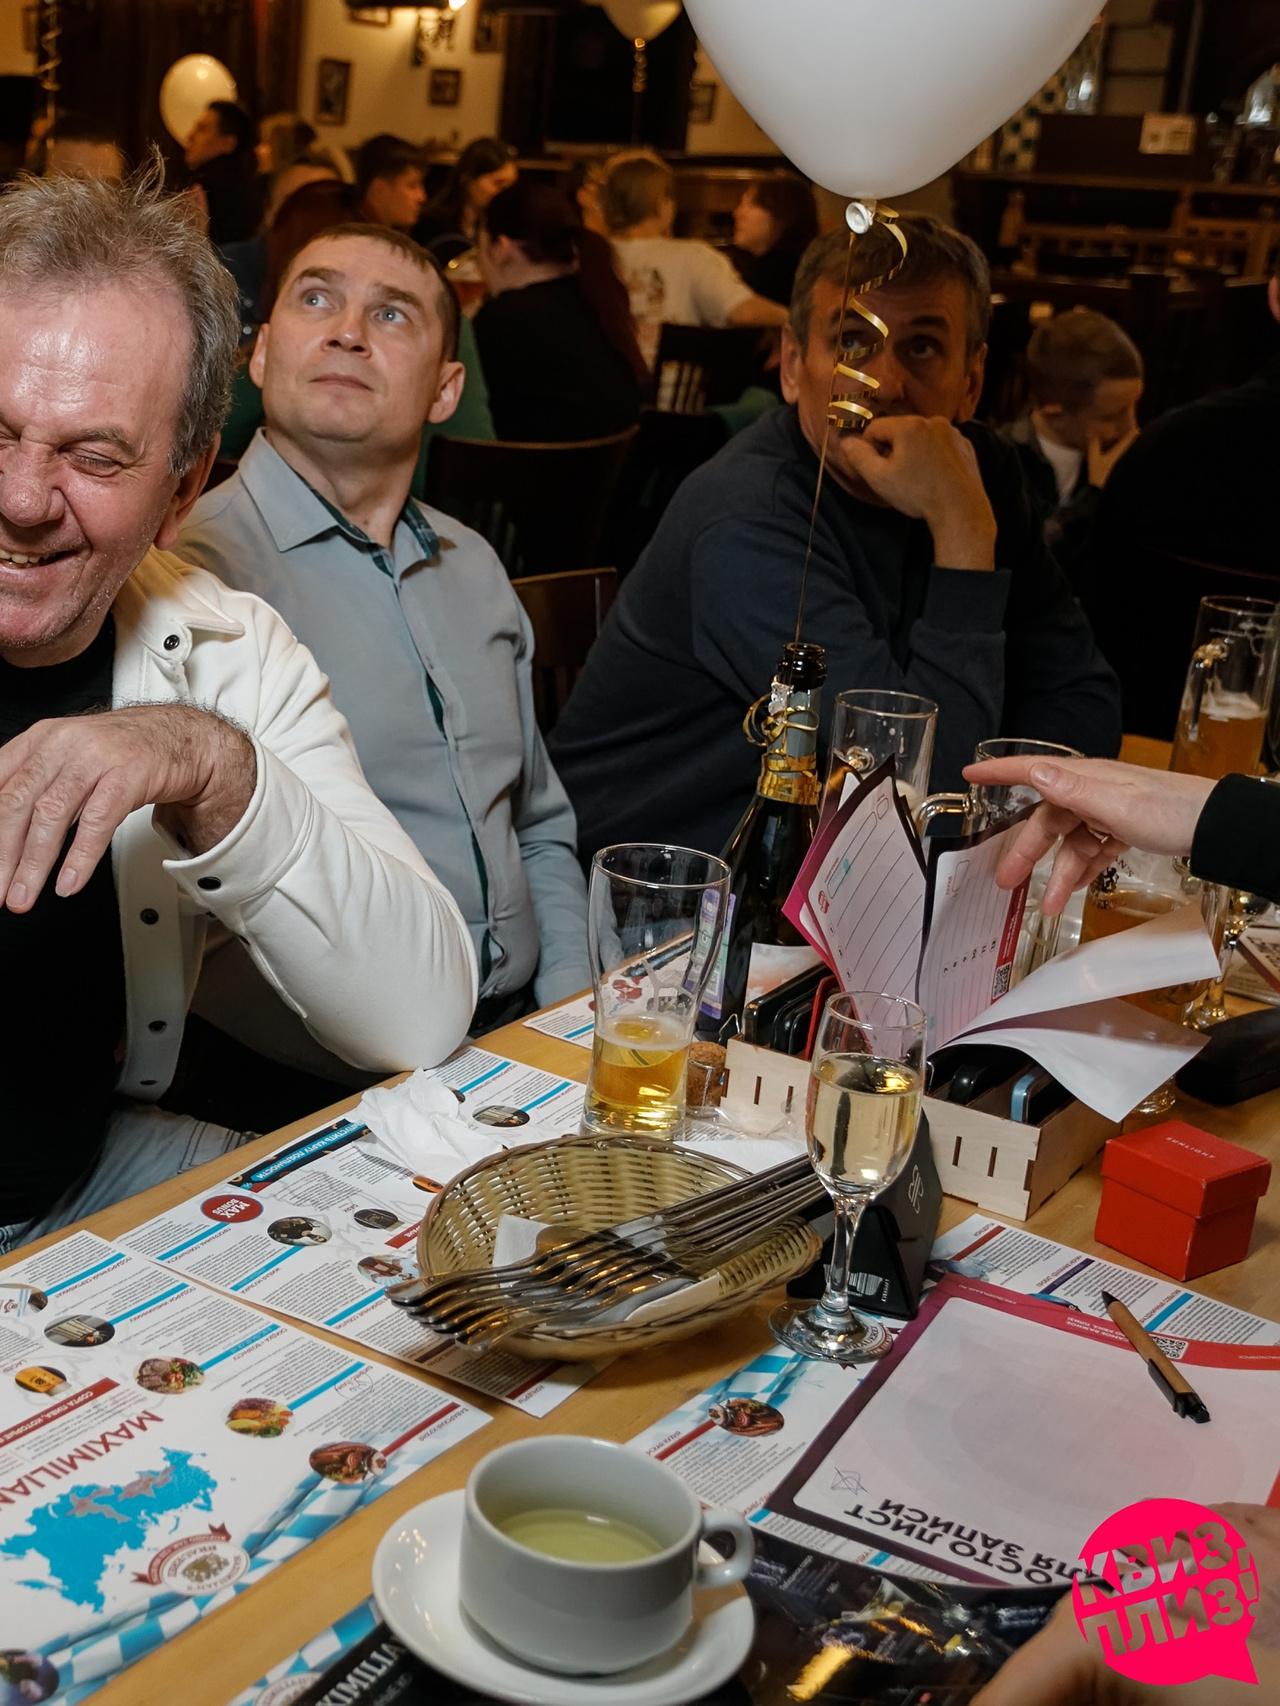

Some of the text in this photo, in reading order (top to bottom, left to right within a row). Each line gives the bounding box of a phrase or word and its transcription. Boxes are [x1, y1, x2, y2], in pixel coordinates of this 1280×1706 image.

[302, 1137, 326, 1156] КАРТУ
[1164, 1135, 1216, 1160] SUNLIGHT
[210, 1196, 240, 1216] BONUS
[219, 1198, 251, 1220] MAX
[1065, 1320, 1128, 1342] САМОЕ ВАЖНОЕ
[1066, 1316, 1090, 1326] ПЛИЗ!
[66, 1387, 94, 1407] СОРТА
[877, 1495, 1024, 1560] ЗАПИСИ
[843, 1498, 1054, 1587] ОСТО ЛИСТ
